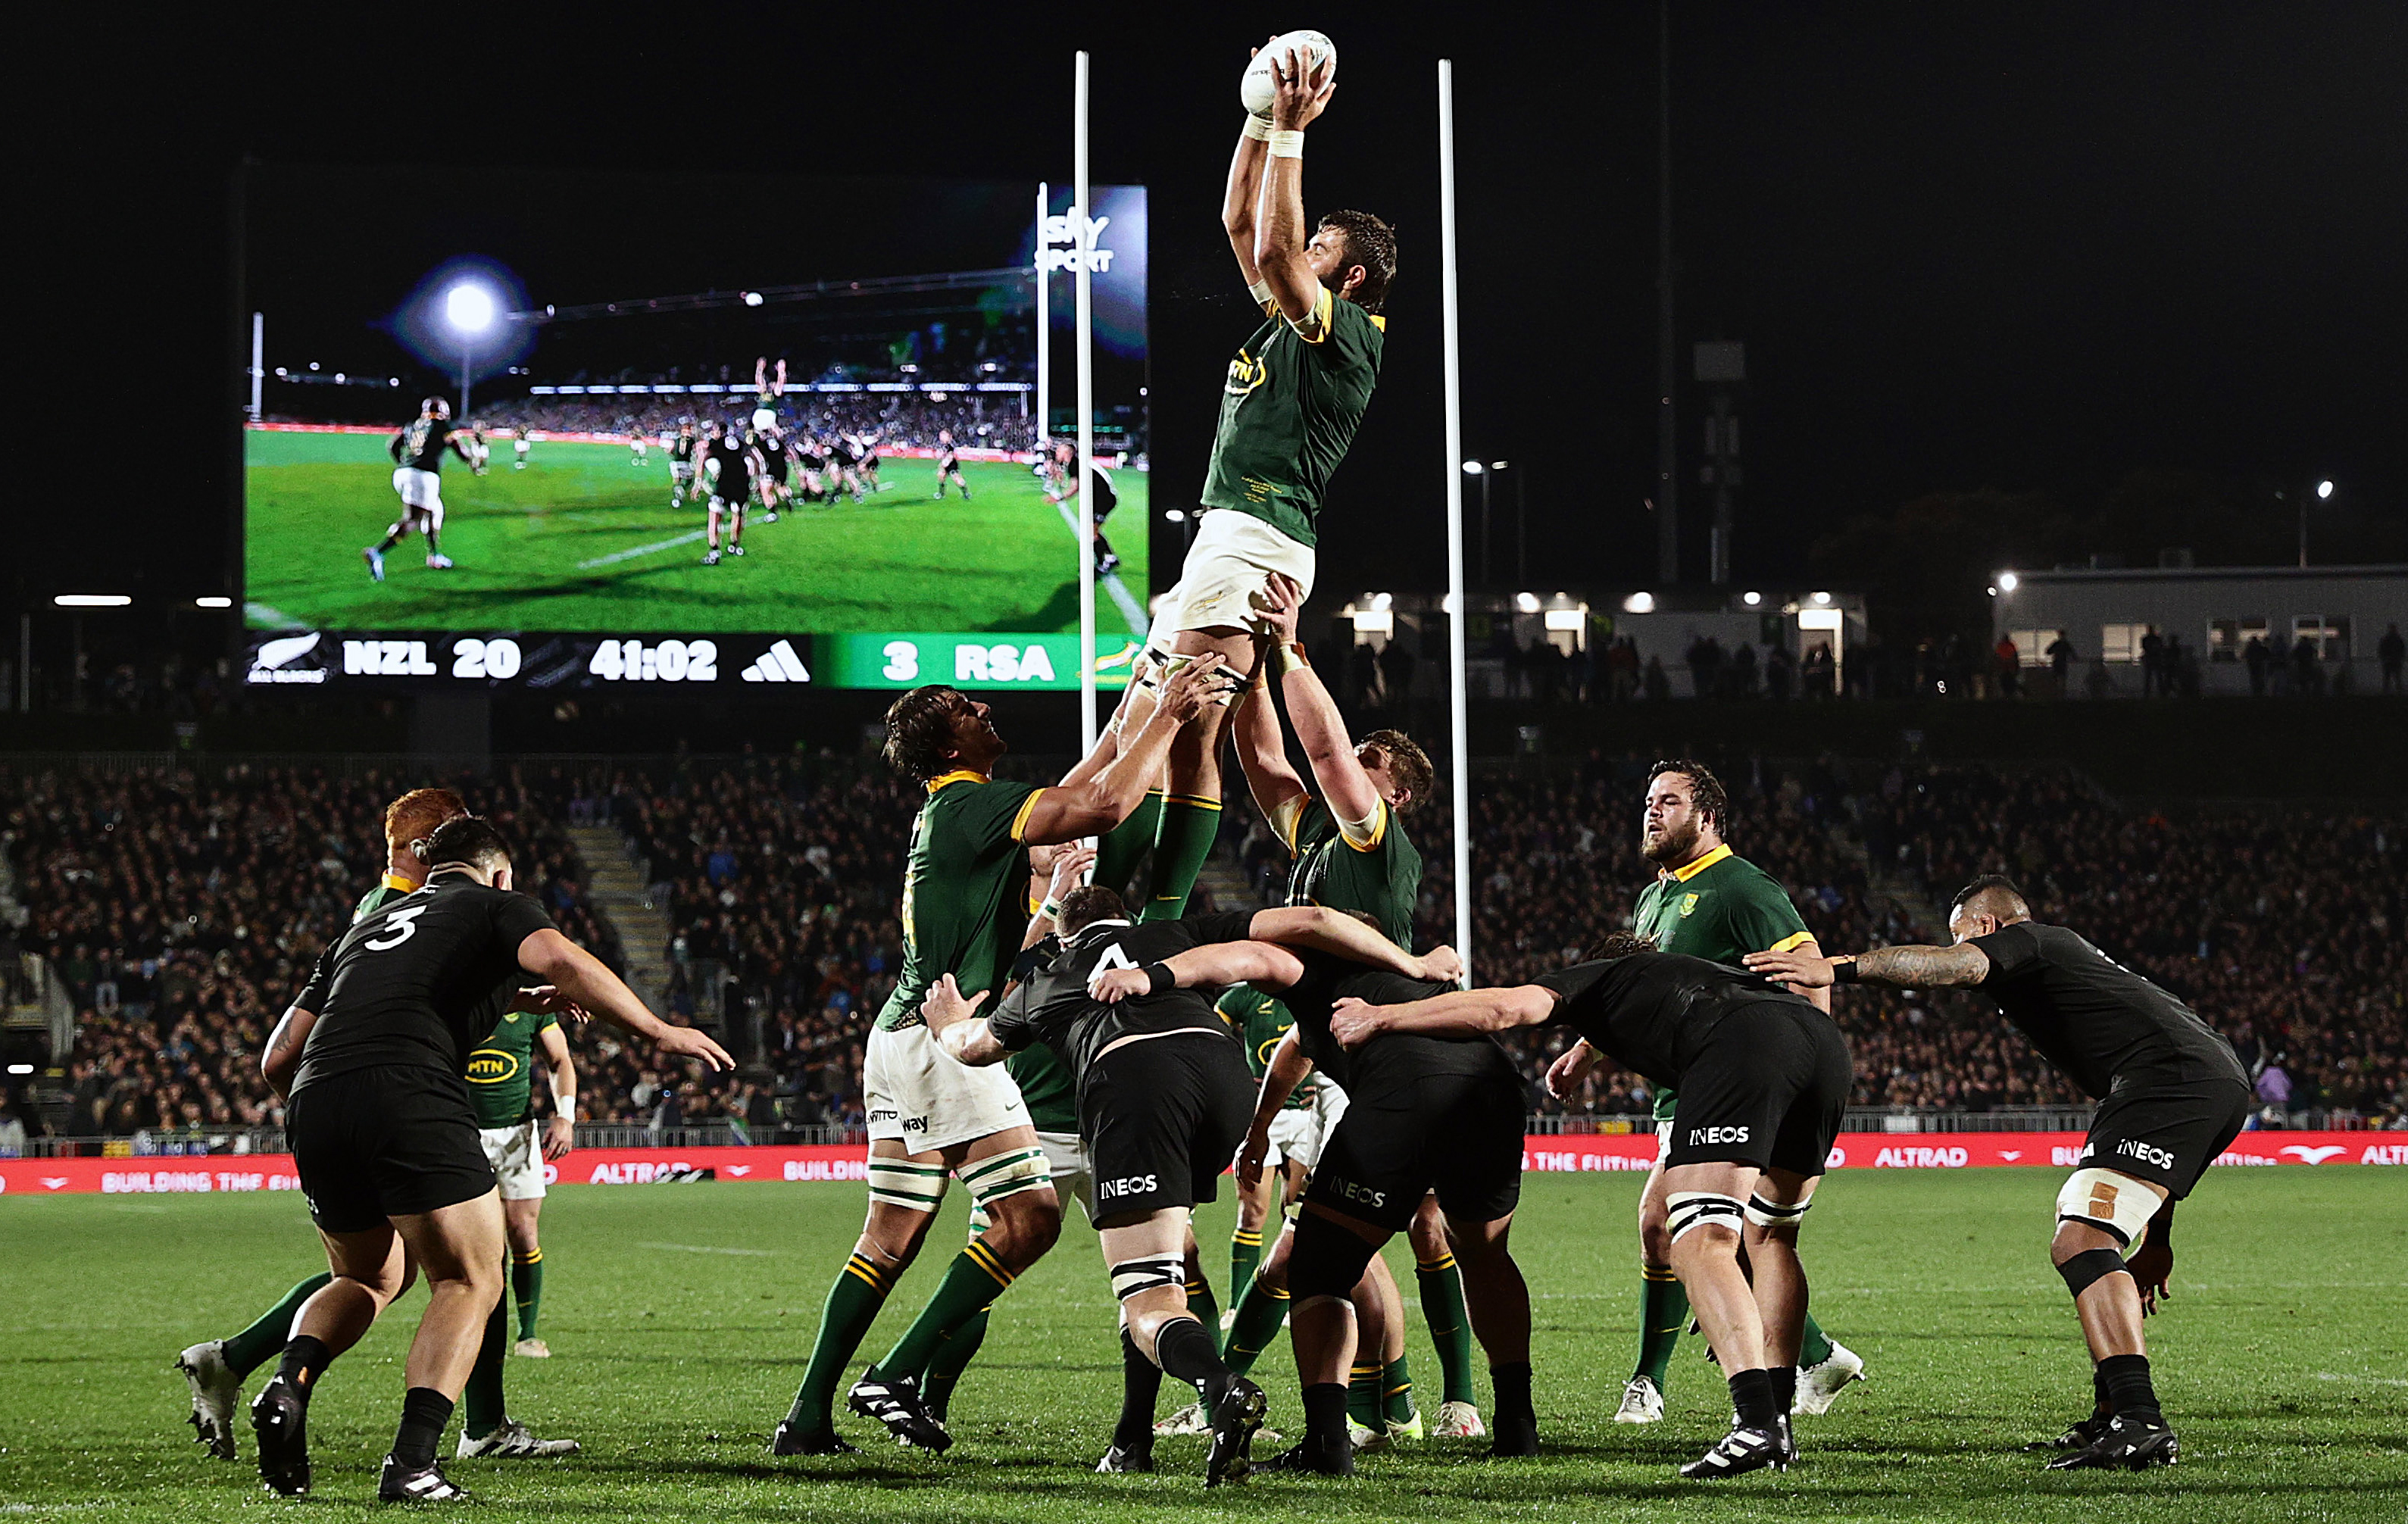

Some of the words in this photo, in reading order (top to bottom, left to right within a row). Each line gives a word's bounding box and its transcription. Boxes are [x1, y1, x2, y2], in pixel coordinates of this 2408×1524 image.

[342, 641, 437, 675] NZL
[452, 639, 522, 679] 20
[589, 639, 717, 681] 41:02
[882, 641, 919, 681] 3
[955, 645, 1056, 681] RSA
[364, 905, 427, 951] 3
[467, 1060, 504, 1073] MTN
[1689, 1126, 1749, 1145] INEOS
[1534, 1151, 1577, 1172] THE
[1874, 1147, 1969, 1168] ALTRAD
[2116, 1138, 2175, 1170] INEOS
[2360, 1145, 2408, 1166] ALT
[783, 1160, 870, 1181] BUILDIN
[102, 1172, 212, 1193] BUILDING
[215, 1173, 264, 1192] THE
[1101, 1174, 1157, 1199] INEOS
[1329, 1176, 1385, 1208] INEOS
